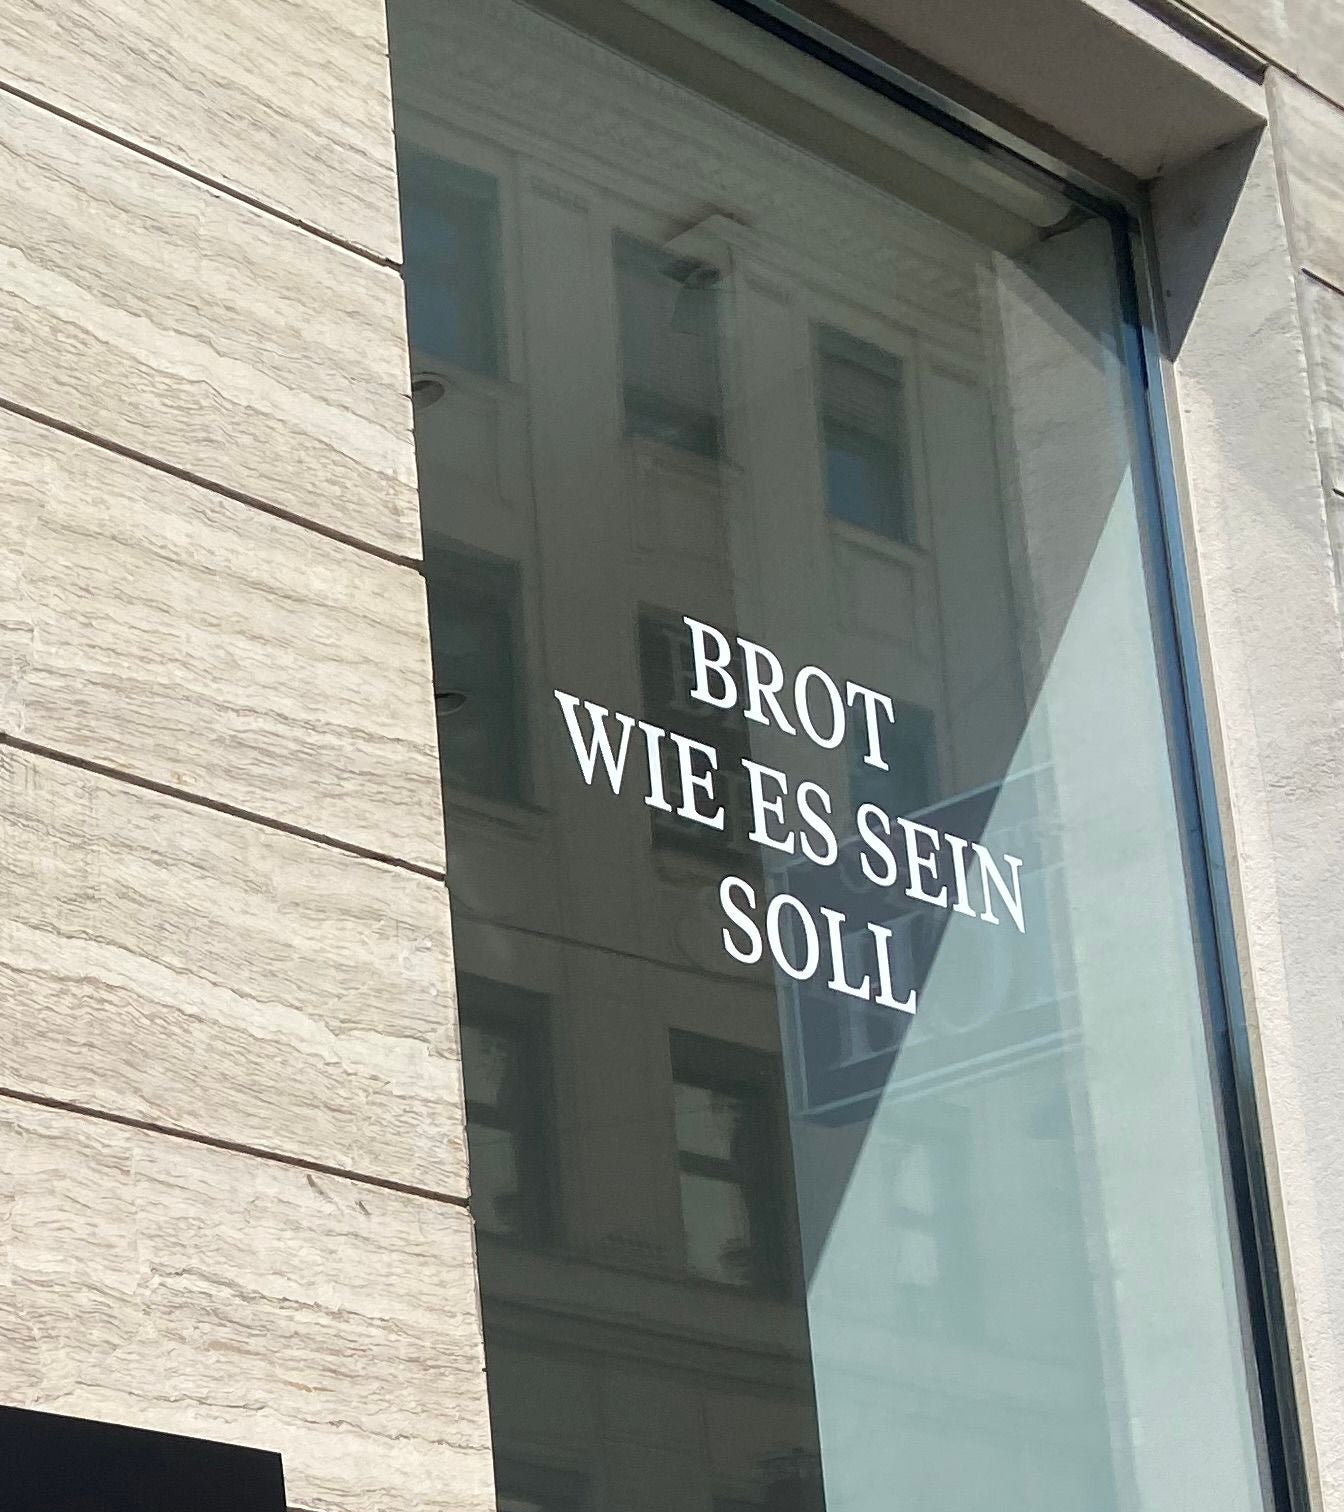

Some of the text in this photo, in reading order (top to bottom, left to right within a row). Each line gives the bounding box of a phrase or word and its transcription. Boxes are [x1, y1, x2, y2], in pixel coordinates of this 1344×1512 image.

[683, 616, 896, 771] BROT
[555, 689, 1026, 934] WIE ES SEIN
[718, 875, 918, 1015] SOLL
